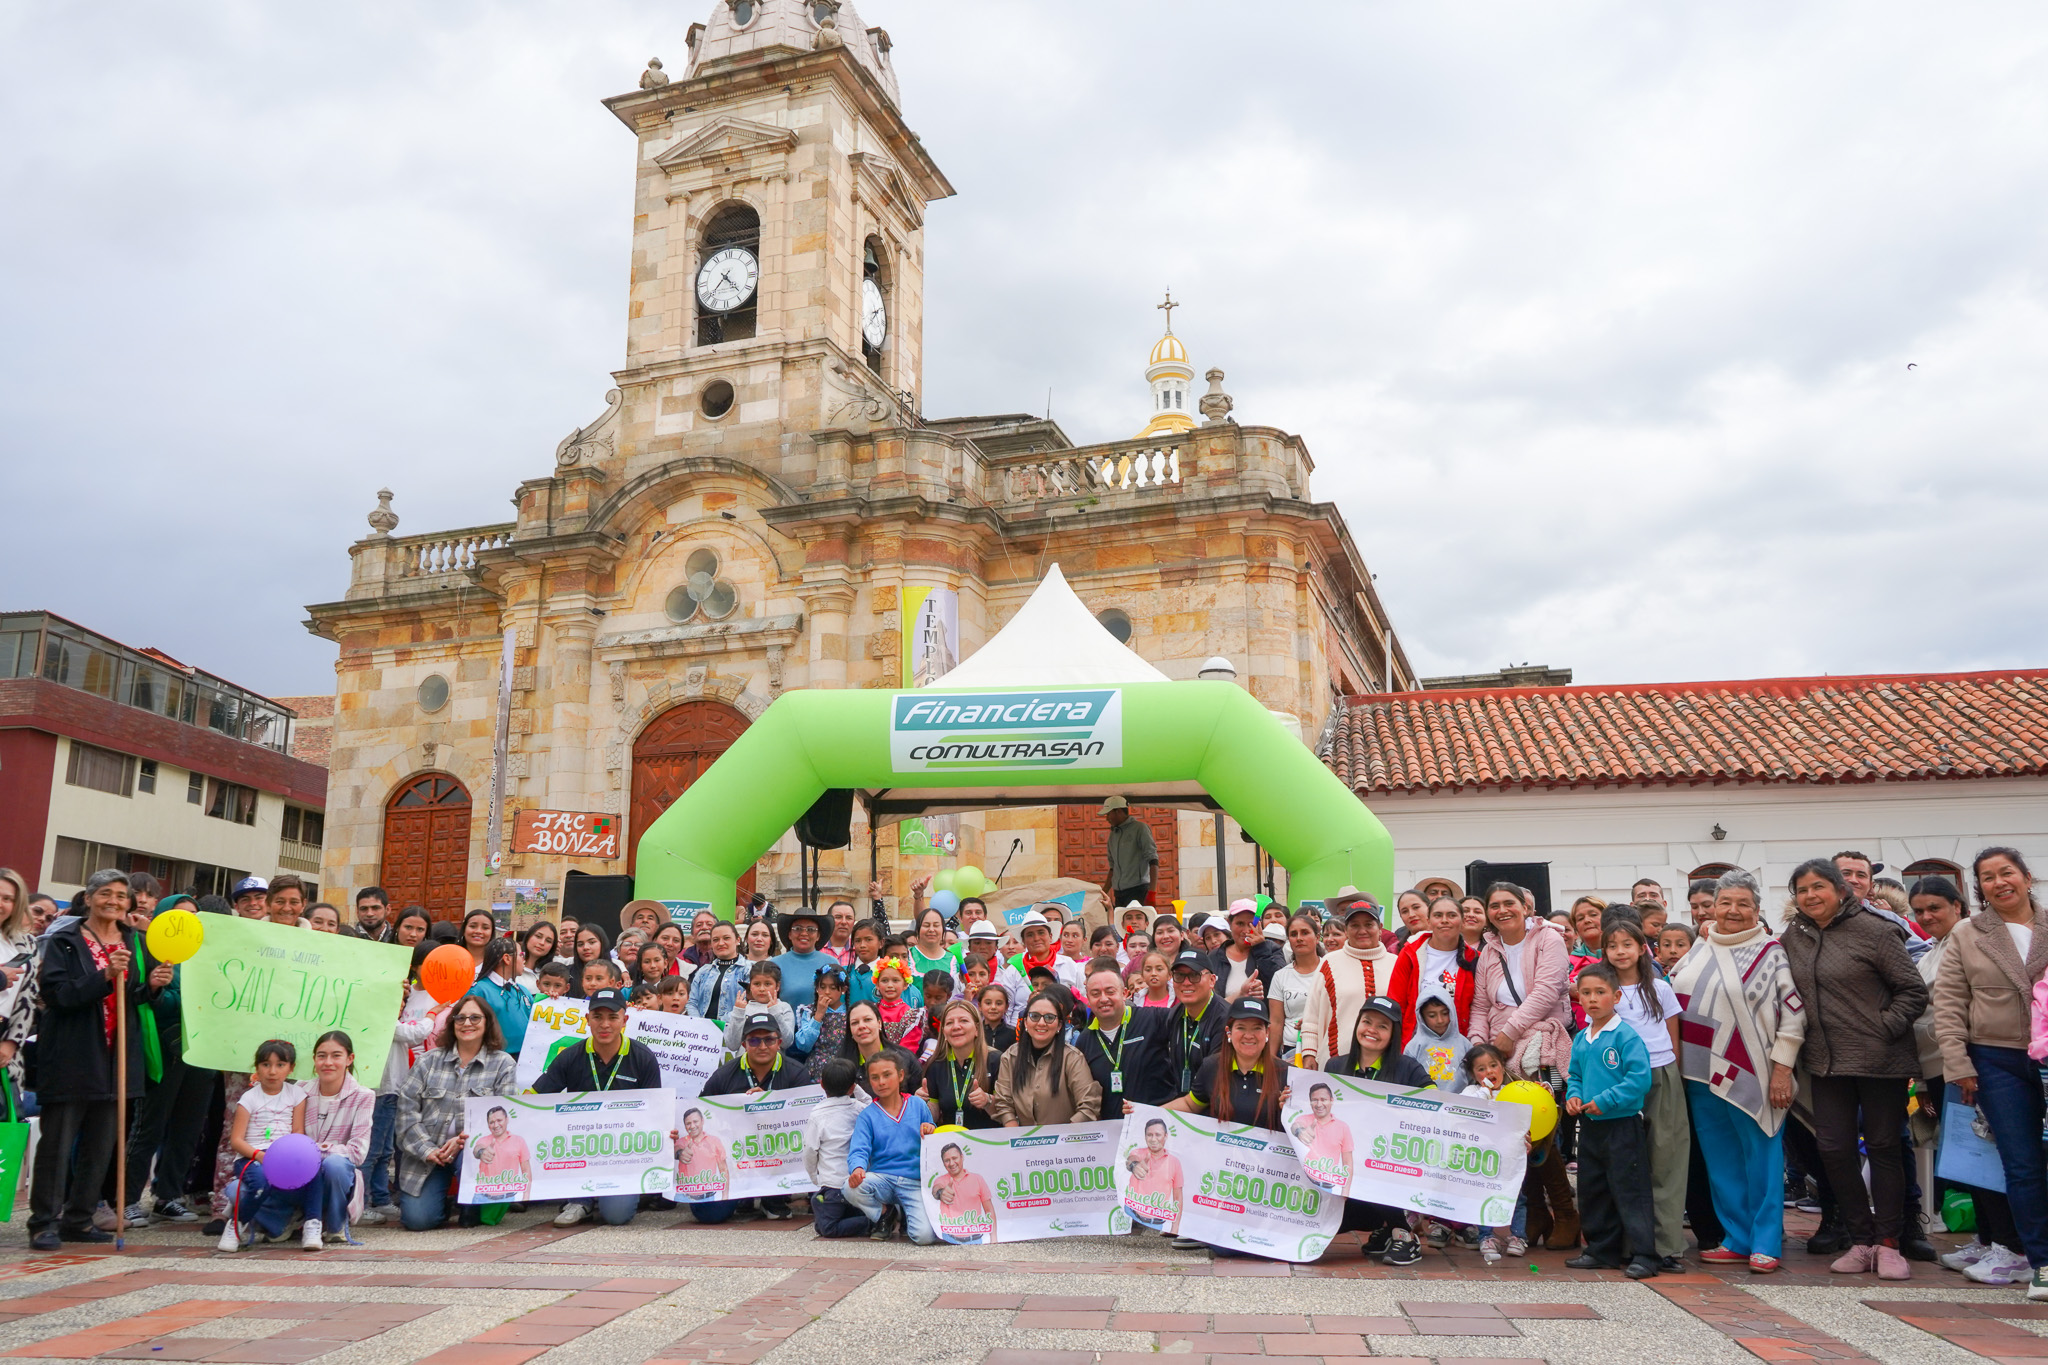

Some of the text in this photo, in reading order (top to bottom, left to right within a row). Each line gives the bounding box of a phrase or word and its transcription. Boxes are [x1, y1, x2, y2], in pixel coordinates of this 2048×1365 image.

[901, 698, 1093, 725] Financiera
[909, 741, 1104, 760] COMULTRASAN
[527, 830, 616, 856] BONZA
[211, 958, 363, 1030] SAN JOSÉ
[532, 1004, 589, 1034] MISI
[638, 1021, 670, 1036] Nuestra
[670, 1053, 691, 1062] social
[693, 1057, 699, 1066] y
[558, 1103, 600, 1112] Financiera
[747, 1102, 783, 1112] Financiera
[1390, 1096, 1439, 1111] Financiera
[567, 1123, 594, 1132] Entrega
[757, 1123, 781, 1131] Entrega
[1399, 1120, 1480, 1142] Entrega la suma de
[1014, 1138, 1056, 1147] Financiera
[1219, 1134, 1265, 1150] Financiera
[565, 1161, 585, 1169] puesto
[609, 1158, 640, 1166] Comunales
[1025, 1159, 1054, 1167] Entrega
[1225, 1158, 1301, 1181] Entrega la suma de
[475, 1169, 529, 1185] Huellas
[675, 1169, 727, 1185] Huellas
[1370, 1160, 1502, 1191] Cuarto puesto Huellas Comunales 2025
[476, 1183, 526, 1193] comunales
[678, 1182, 724, 1193] comunales
[1028, 1199, 1049, 1208] puesto
[1074, 1195, 1106, 1203] Comunales
[1124, 1184, 1180, 1213] Huellas
[1125, 1198, 1175, 1221] comunales
[1197, 1196, 1320, 1229] Quinto puesto Huellas Comunales 2025
[939, 1210, 993, 1226] Huellas
[942, 1224, 991, 1234] comunales
